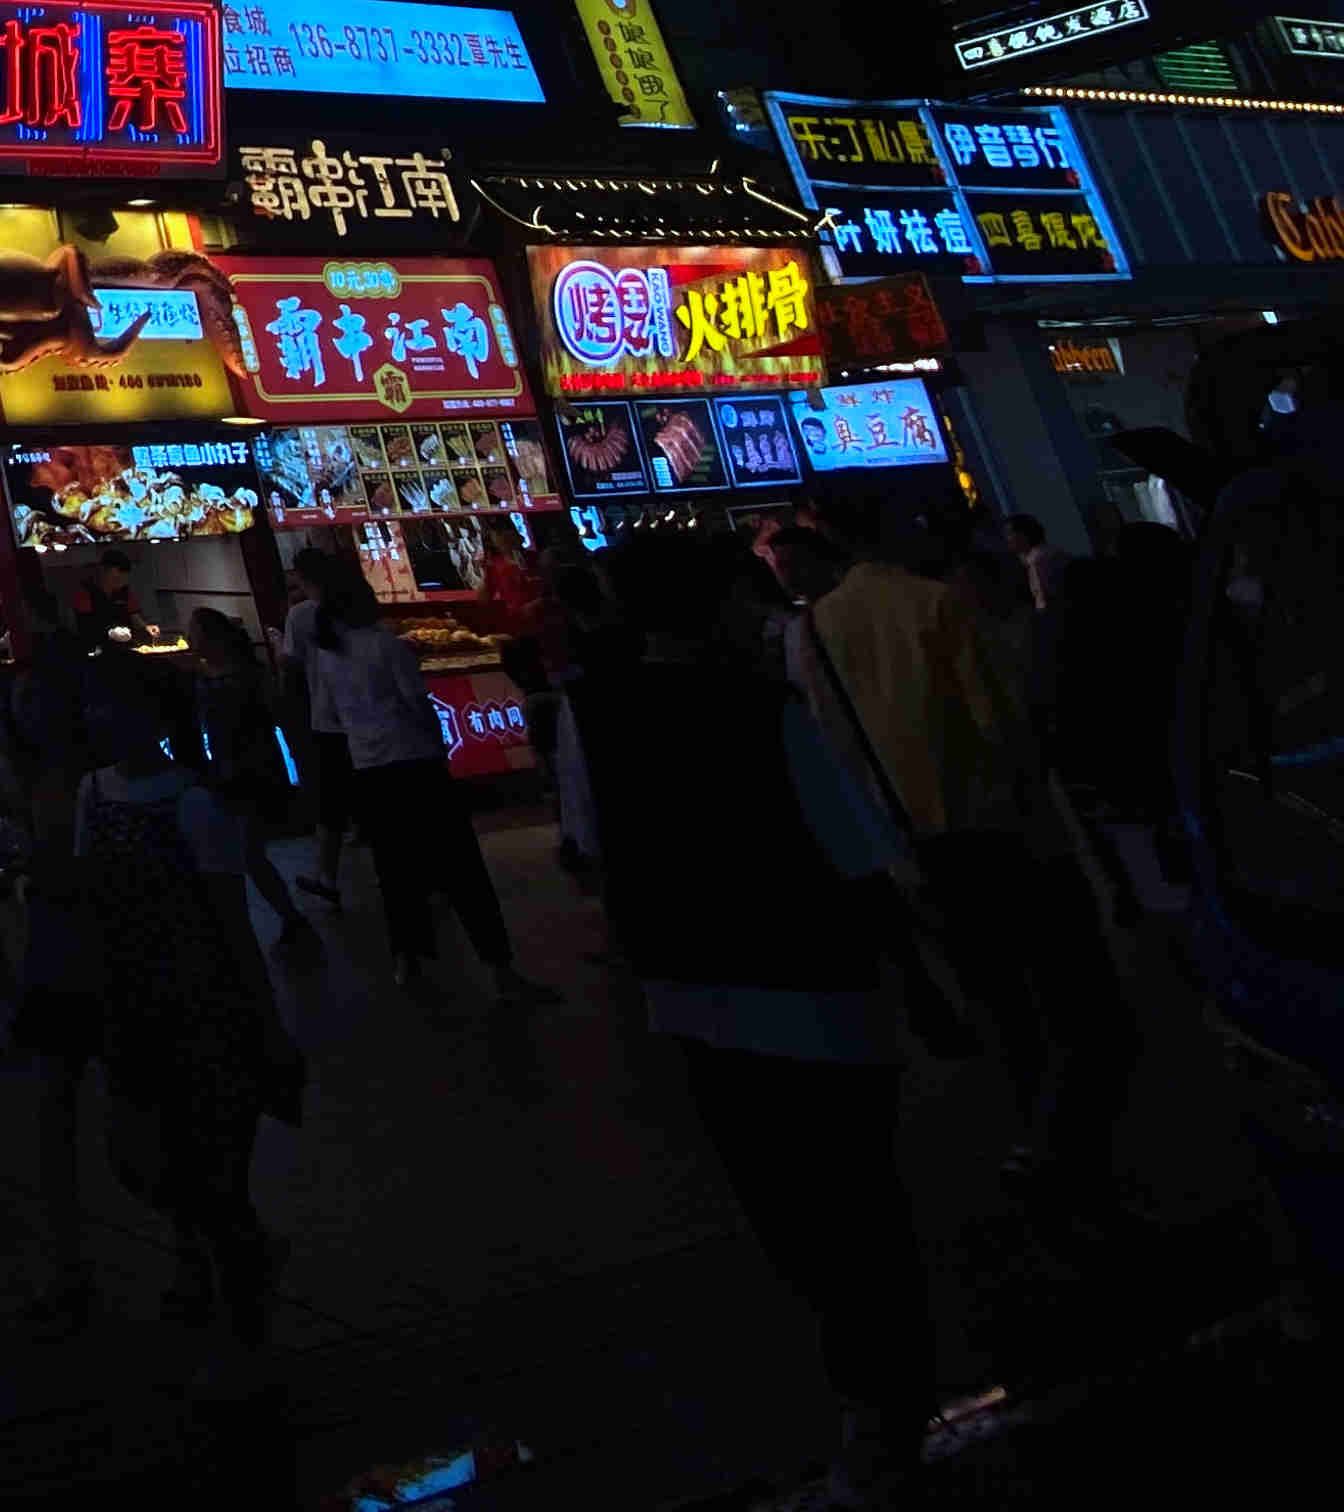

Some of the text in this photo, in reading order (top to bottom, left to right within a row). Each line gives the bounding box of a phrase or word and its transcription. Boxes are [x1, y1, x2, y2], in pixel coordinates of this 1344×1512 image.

[239, 139, 462, 237] 霸串江南
[675, 260, 810, 363] 火排骨
[831, 406, 937, 453] 臭豆腐
